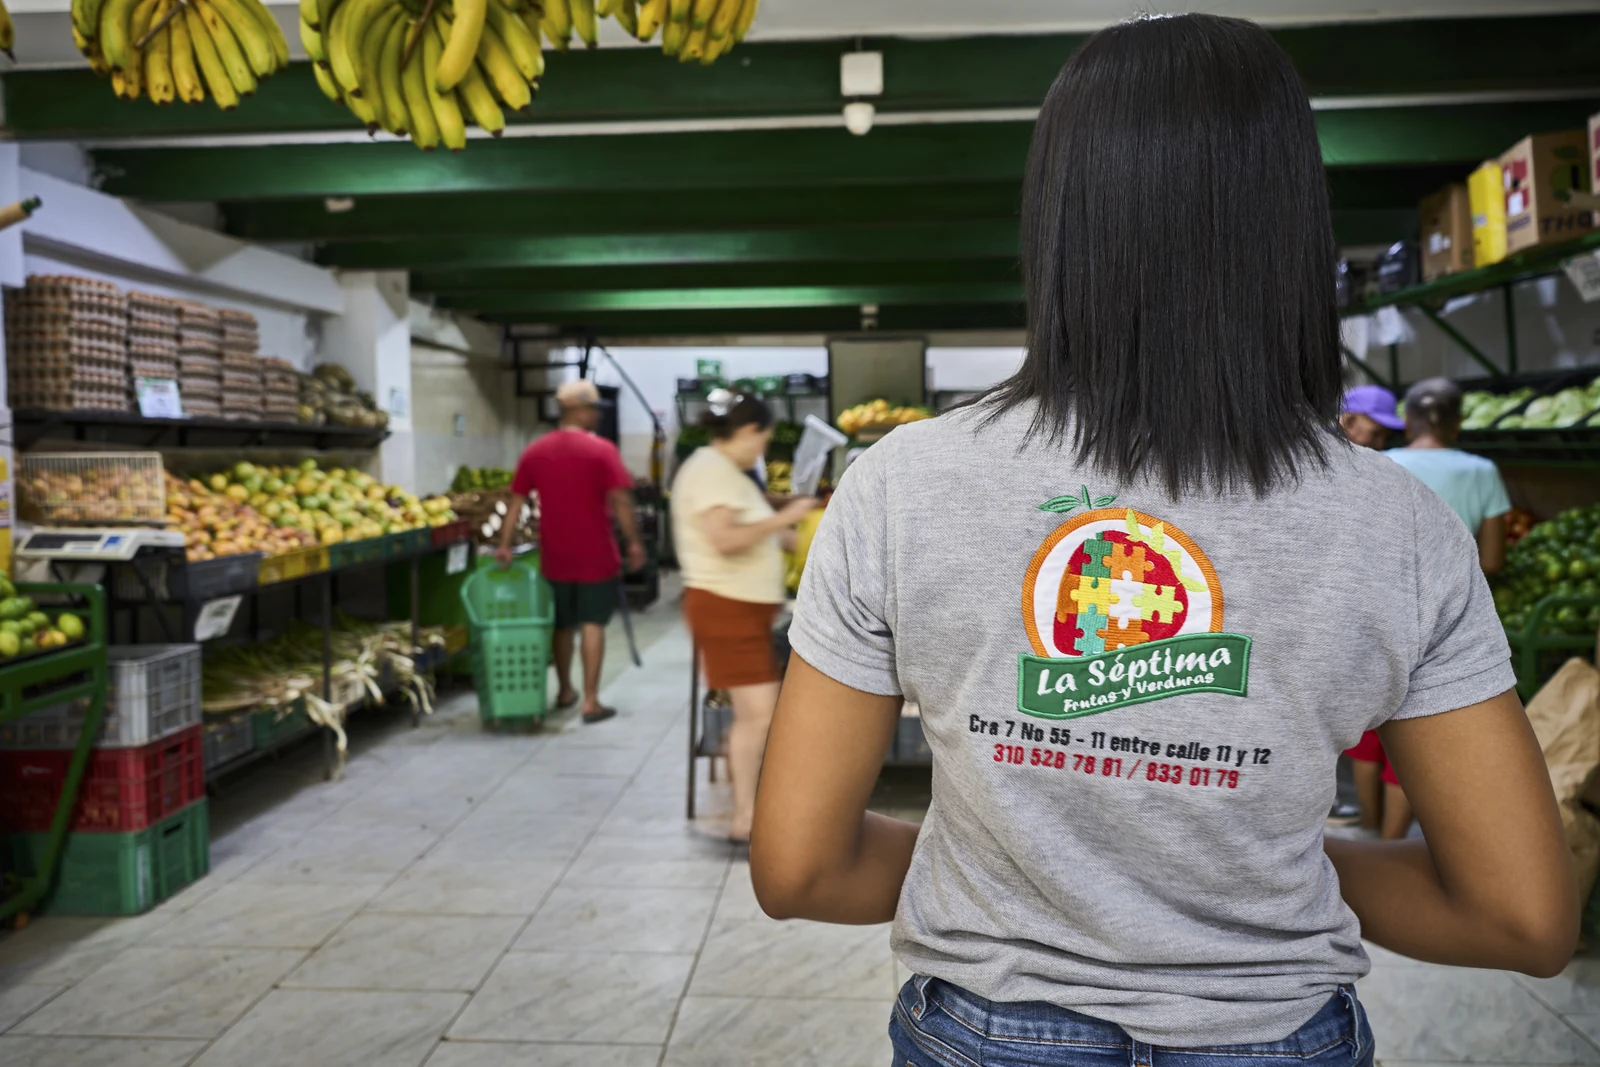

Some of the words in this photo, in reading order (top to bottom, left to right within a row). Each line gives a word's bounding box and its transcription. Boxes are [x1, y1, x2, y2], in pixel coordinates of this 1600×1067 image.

[1037, 668, 1078, 696] La
[1087, 647, 1232, 687] Séptima
[1063, 691, 1118, 713] Frutas
[1118, 687, 1132, 701] y
[1135, 672, 1215, 694] Verduras
[969, 713, 999, 736] Cra
[1005, 719, 1015, 737] 7
[1021, 722, 1045, 742] No
[1049, 727, 1071, 746] 55
[1091, 731, 1105, 749] 11
[1110, 736, 1161, 756] entre
[1165, 742, 1211, 761] calle
[1216, 745, 1232, 763] 11
[1235, 750, 1248, 767] y
[1253, 748, 1272, 765] 12
[993, 743, 1025, 765] 310
[1030, 748, 1066, 769] 528
[1072, 754, 1096, 774] 78
[1101, 757, 1122, 777] 81
[1127, 759, 1142, 780] /
[1146, 762, 1183, 784] 833
[1189, 767, 1211, 786] 01
[1217, 769, 1240, 789] 79
